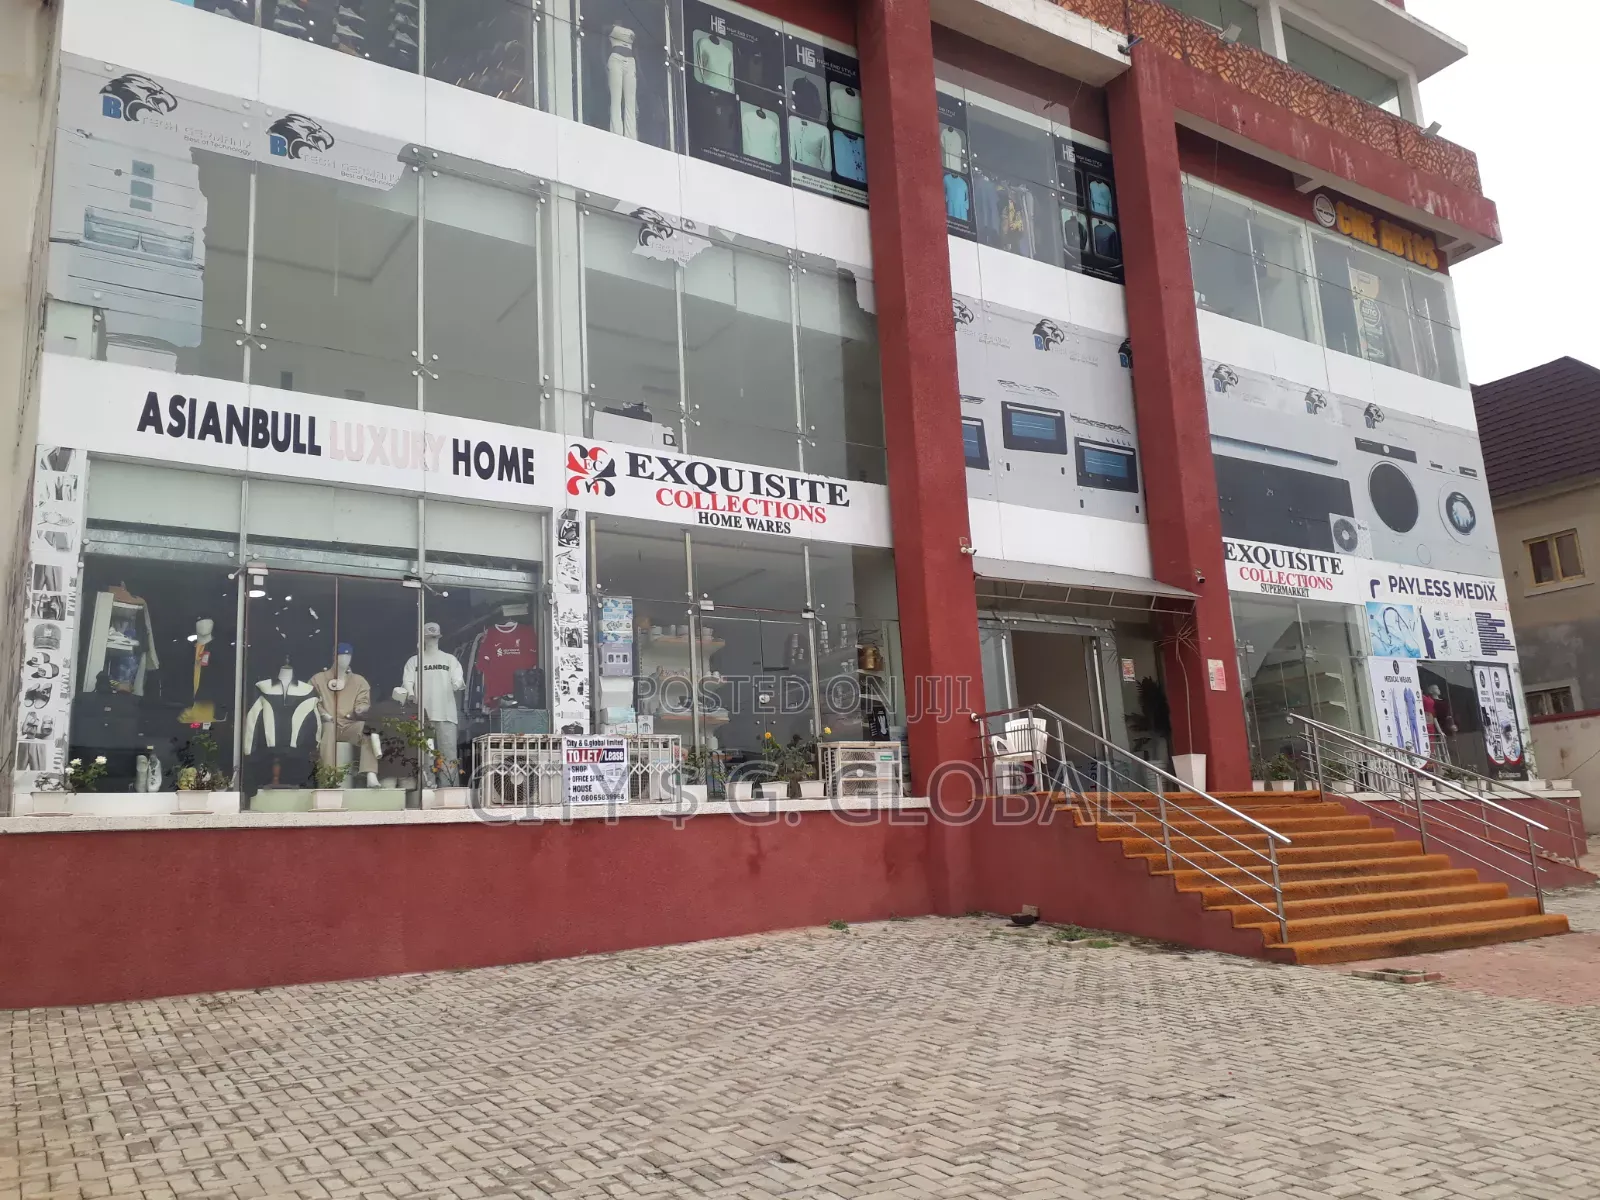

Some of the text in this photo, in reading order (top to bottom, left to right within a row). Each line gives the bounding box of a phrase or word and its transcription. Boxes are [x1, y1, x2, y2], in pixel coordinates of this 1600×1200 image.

[211, 140, 251, 156] Technology
[136, 391, 535, 485] ASIANBULL LUXURY HOME
[624, 451, 850, 507] EXQUISITE
[655, 487, 827, 524] COLLECTIONS
[698, 511, 791, 535] HOME WARES
[1223, 541, 1344, 576] EXQUISITE
[1239, 566, 1333, 591] COLLECTIONS
[1260, 582, 1310, 598] SUPERMARKET
[1388, 575, 1498, 602] PAYLESS MEDIX
[1384, 675, 1400, 683] MEDICAL
[566, 739, 577, 748] City
[568, 750, 580, 763] TO
[582, 750, 598, 762] LET
[571, 765, 588, 773] SHOP
[572, 775, 589, 783] OFFICE
[572, 784, 593, 793] HOUSE
[568, 794, 580, 802] Tel:
